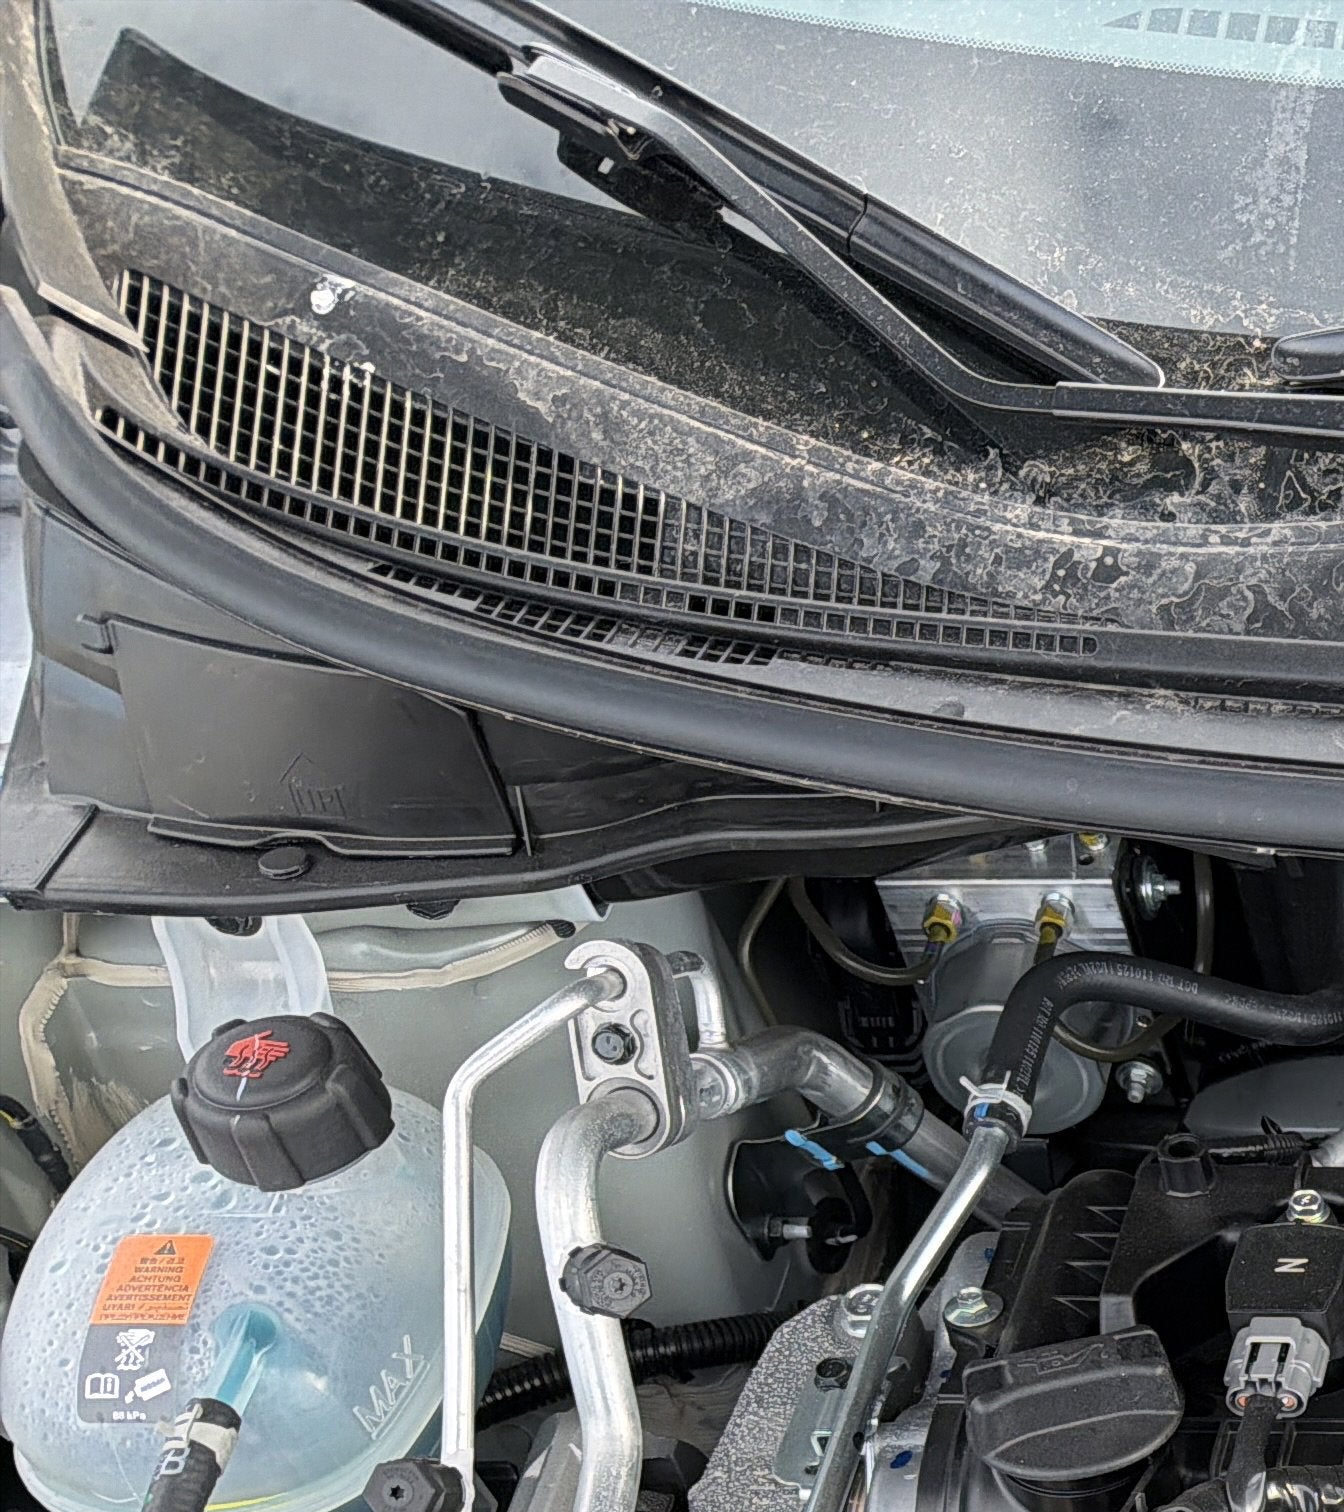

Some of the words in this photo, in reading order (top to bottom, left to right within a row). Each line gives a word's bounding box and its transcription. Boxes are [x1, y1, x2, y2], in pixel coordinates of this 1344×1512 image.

[134, 1265, 185, 1273] WARNING
[128, 1275, 182, 1283] ACHTUNG
[352, 1334, 425, 1434] MAX
